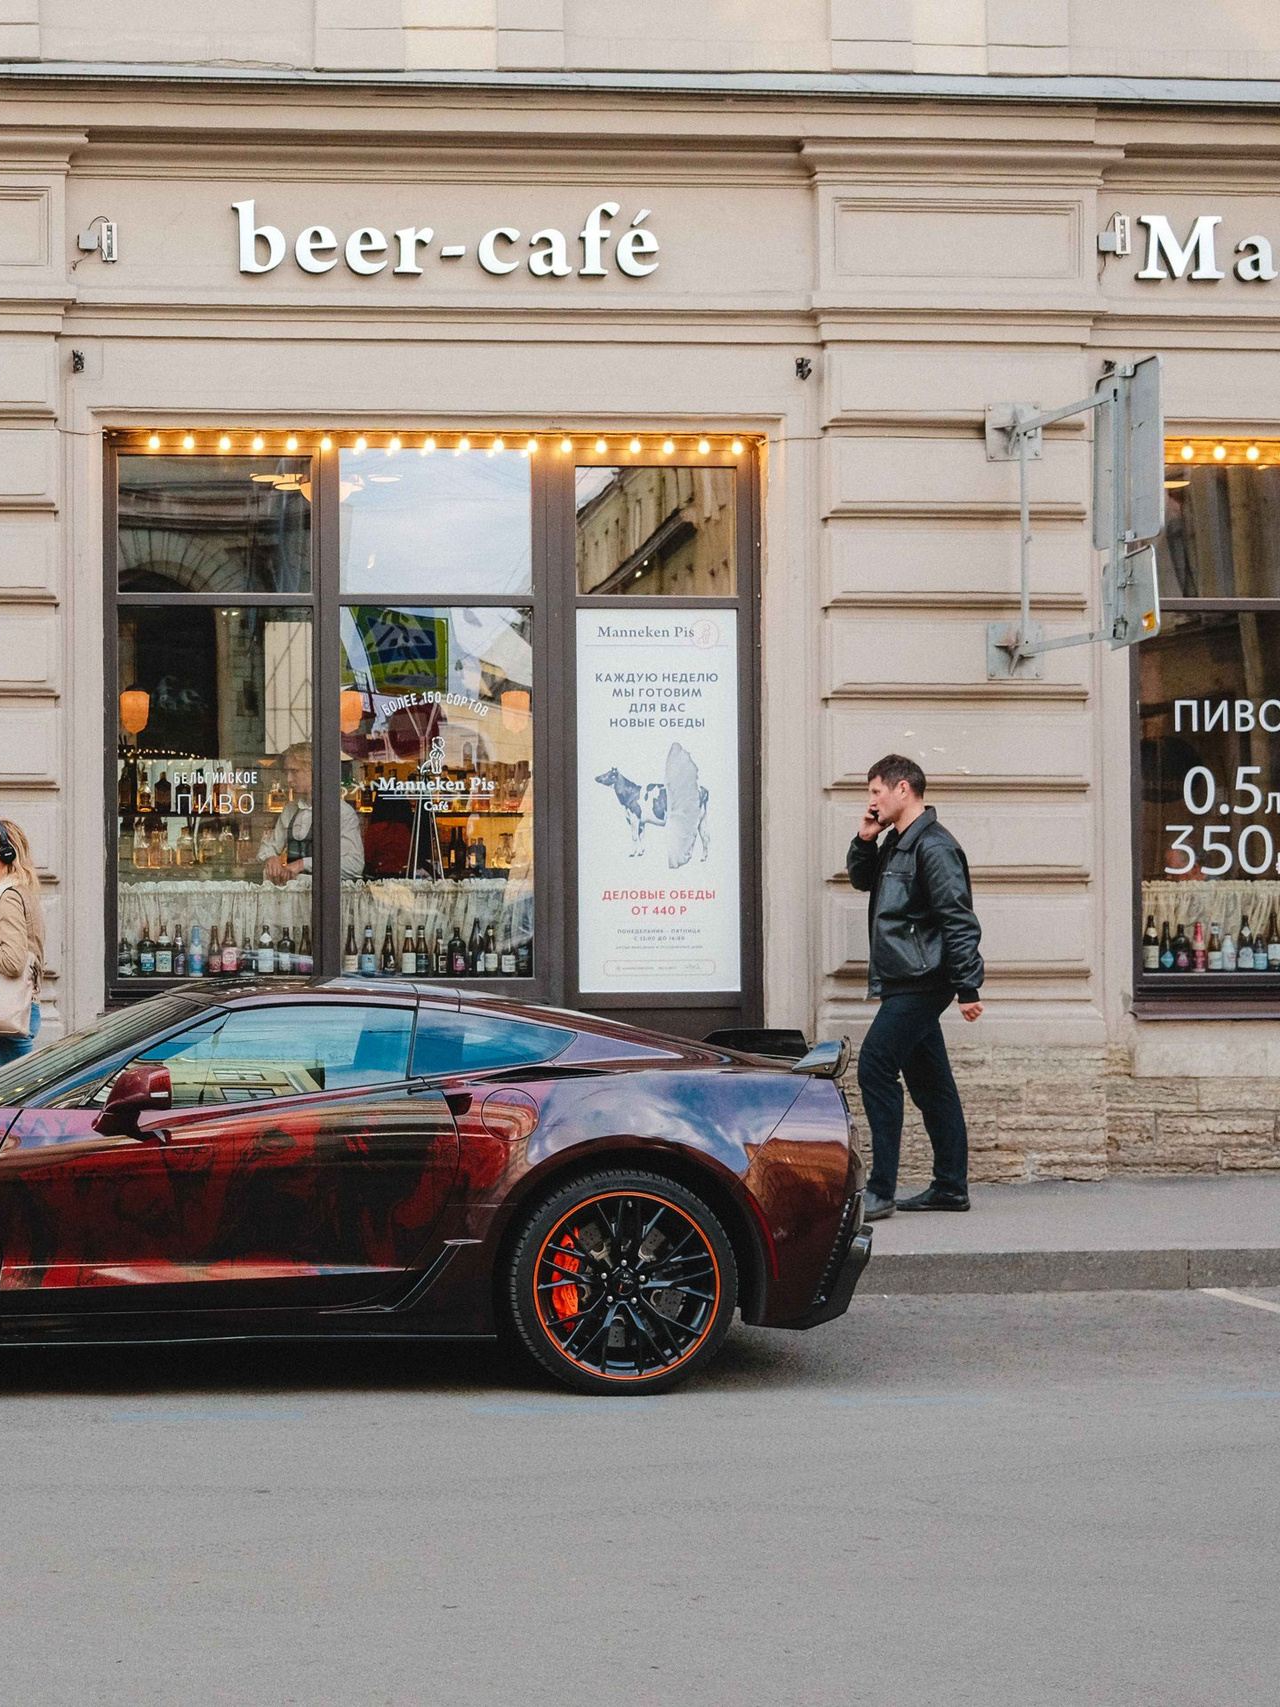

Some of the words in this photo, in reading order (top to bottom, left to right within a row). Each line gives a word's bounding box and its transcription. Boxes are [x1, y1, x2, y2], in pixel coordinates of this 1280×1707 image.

[231, 199, 661, 279] beer-café
[1135, 213, 1280, 284] Ma
[597, 626, 670, 638] Manneken
[674, 626, 695, 638] Pis
[595, 673, 658, 684] КАЖДУЮ
[662, 673, 719, 684] НЕДЕЛЮ
[612, 688, 634, 698] МЫ
[638, 688, 702, 698] ГОТОВИМ
[381, 693, 419, 717] БОЛЕЕ
[422, 691, 442, 704] 150
[446, 692, 490, 718] СОРТОВ
[628, 703, 656, 714] ДЛЯ
[660, 703, 686, 713] ВАС
[1174, 699, 1280, 732] ПИВО
[609, 718, 655, 728] НОВЫЕ
[659, 718, 705, 729] ОБЕДЫ
[378, 776, 466, 791] Manneken
[469, 776, 495, 791] Pis
[177, 793, 255, 815] ПИВО
[423, 800, 449, 811] Café
[1164, 825, 1280, 876] 350
[602, 890, 666, 901] ДЕЛОВЫЕ
[669, 890, 716, 901] ОБЕДЫ
[631, 906, 649, 916] ОТ
[652, 906, 676, 916] 440
